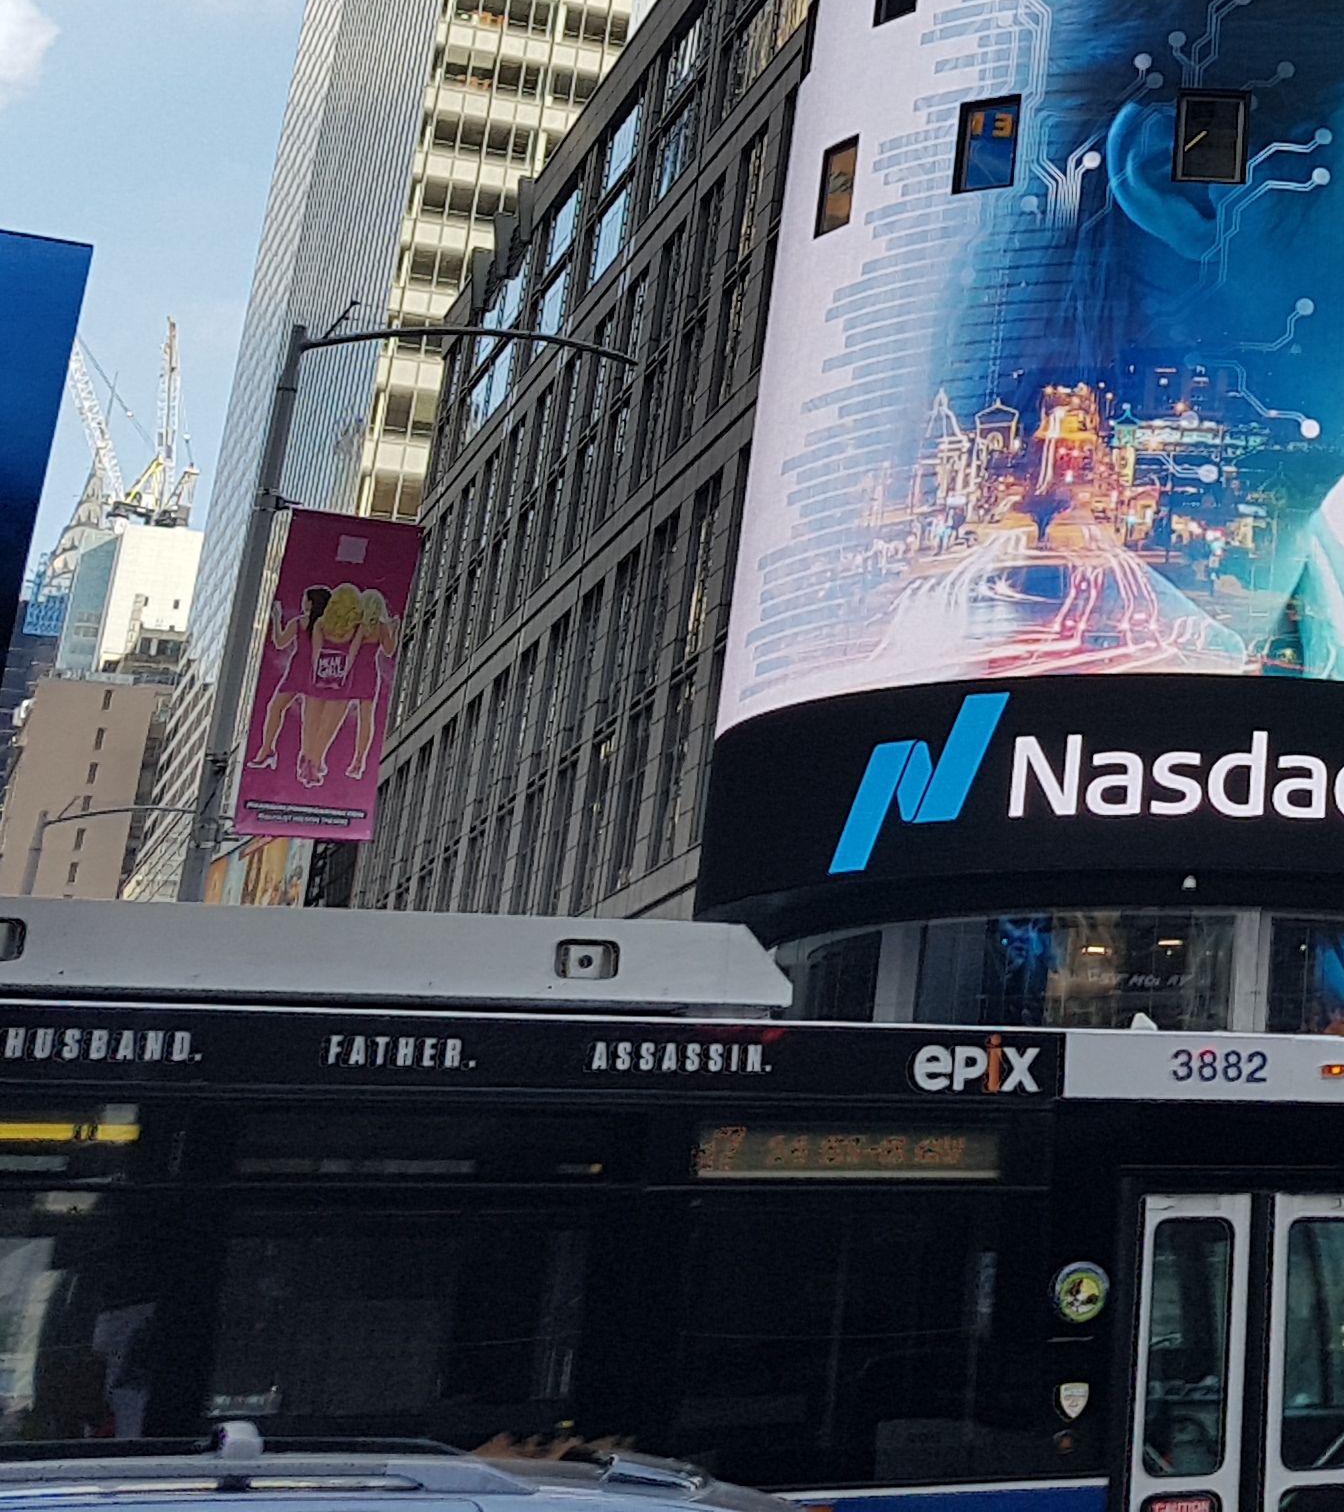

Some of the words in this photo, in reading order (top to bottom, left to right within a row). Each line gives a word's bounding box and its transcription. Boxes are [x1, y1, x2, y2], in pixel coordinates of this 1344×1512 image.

[3, 1027, 203, 1062] HUSBAND.
[328, 1034, 477, 1068] FATHER.
[591, 1041, 773, 1073] ASSASSIN.
[913, 1033, 1041, 1094] epix
[1171, 1048, 1269, 1084] 3882
